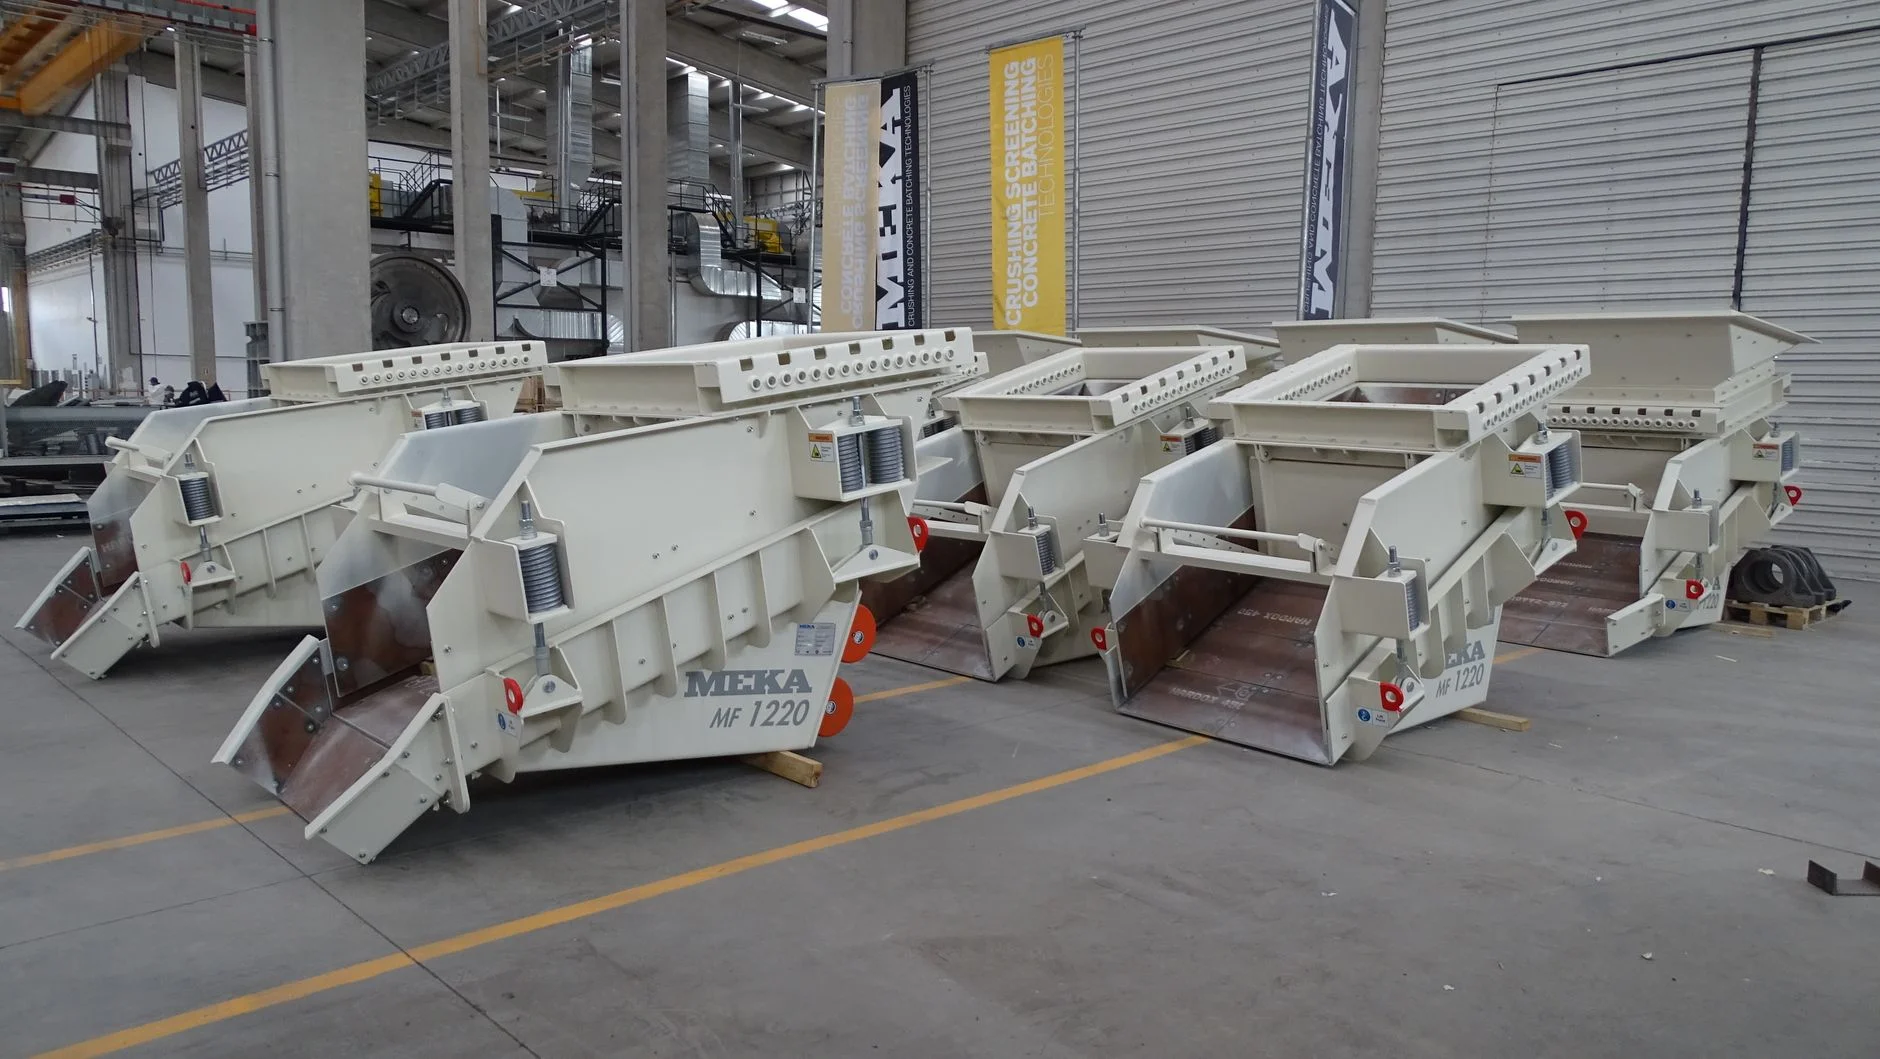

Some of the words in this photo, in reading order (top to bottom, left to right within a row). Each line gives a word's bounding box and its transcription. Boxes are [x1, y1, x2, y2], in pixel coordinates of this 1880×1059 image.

[903, 85, 912, 158] TECHNOLOGIES
[1004, 61, 1021, 199] SCREENING
[1020, 57, 1038, 177] BATCHING
[1037, 54, 1055, 222] TECHNOLOGIES
[904, 158, 913, 205] BATCHING
[876, 88, 905, 329] MEKA
[905, 207, 914, 256] CONCRETE
[906, 257, 914, 277] AND
[1004, 202, 1022, 325] CRUSHING
[1021, 181, 1038, 307] CONCRETE
[907, 278, 915, 327] CRUSHING
[1445, 640, 1485, 670] EKA
[684, 669, 812, 698] MEKA
[1436, 678, 1451, 698] MF
[1455, 663, 1485, 692] 1220
[709, 707, 742, 729] MF
[749, 700, 809, 728] 1220
